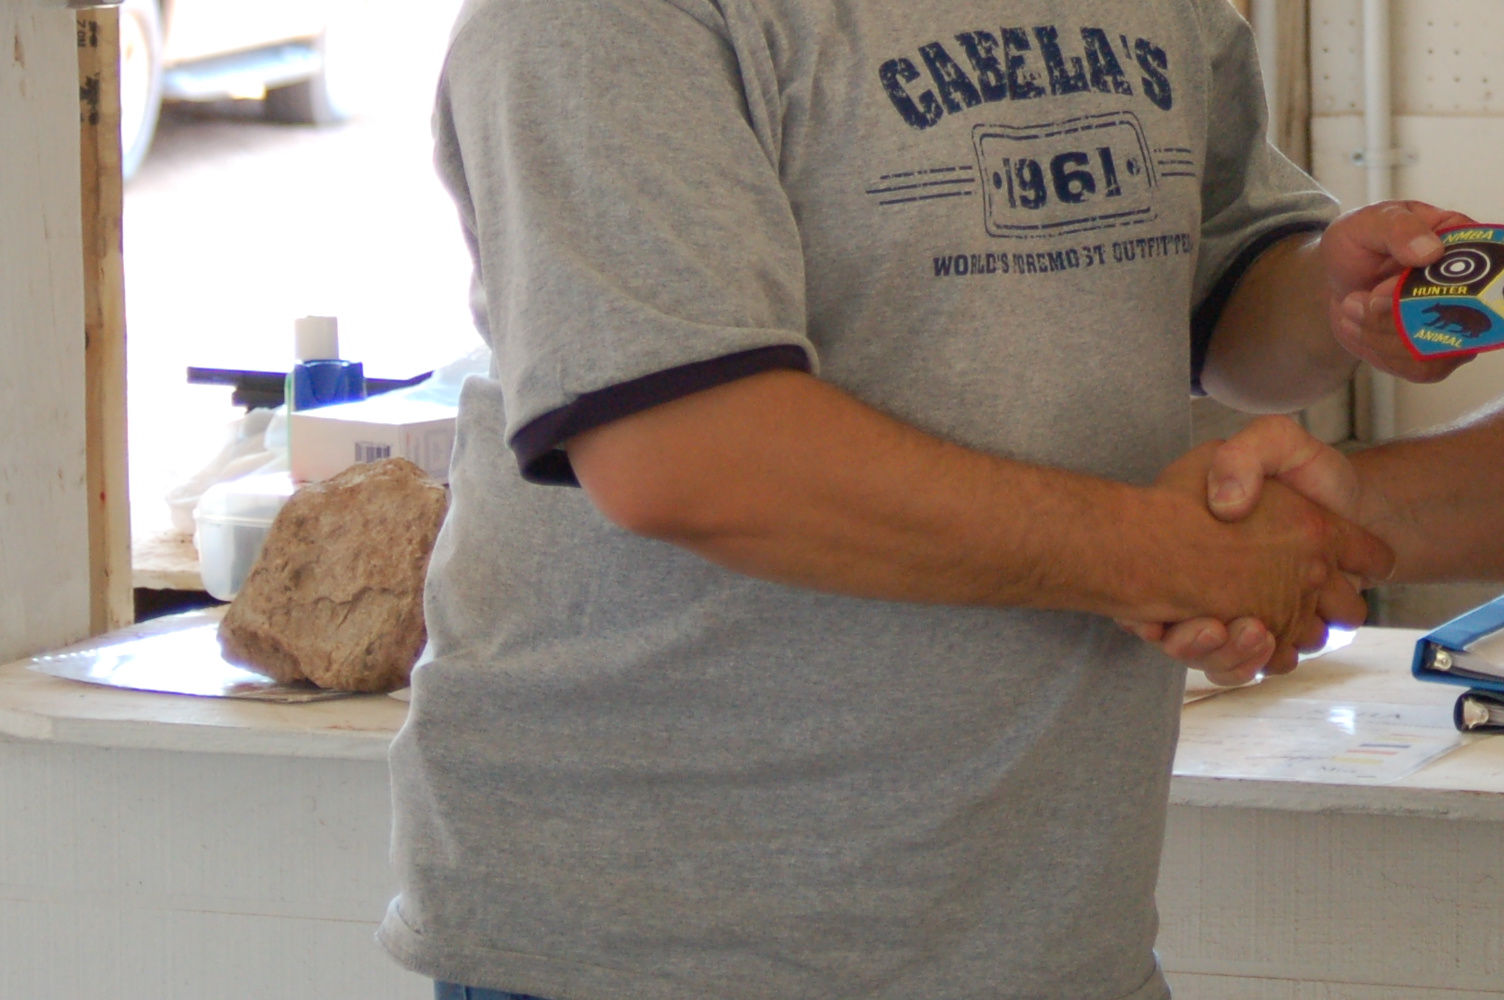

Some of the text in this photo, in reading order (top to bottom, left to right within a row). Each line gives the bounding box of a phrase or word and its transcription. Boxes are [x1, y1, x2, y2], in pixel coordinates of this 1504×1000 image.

[878, 24, 1173, 131] CABELA'S
[1001, 146, 1123, 210] 1961
[933, 243, 1107, 277] WORLD'S FOREMOST
[1411, 285, 1469, 297] HUNTER
[1413, 328, 1464, 349] ANIMAL
